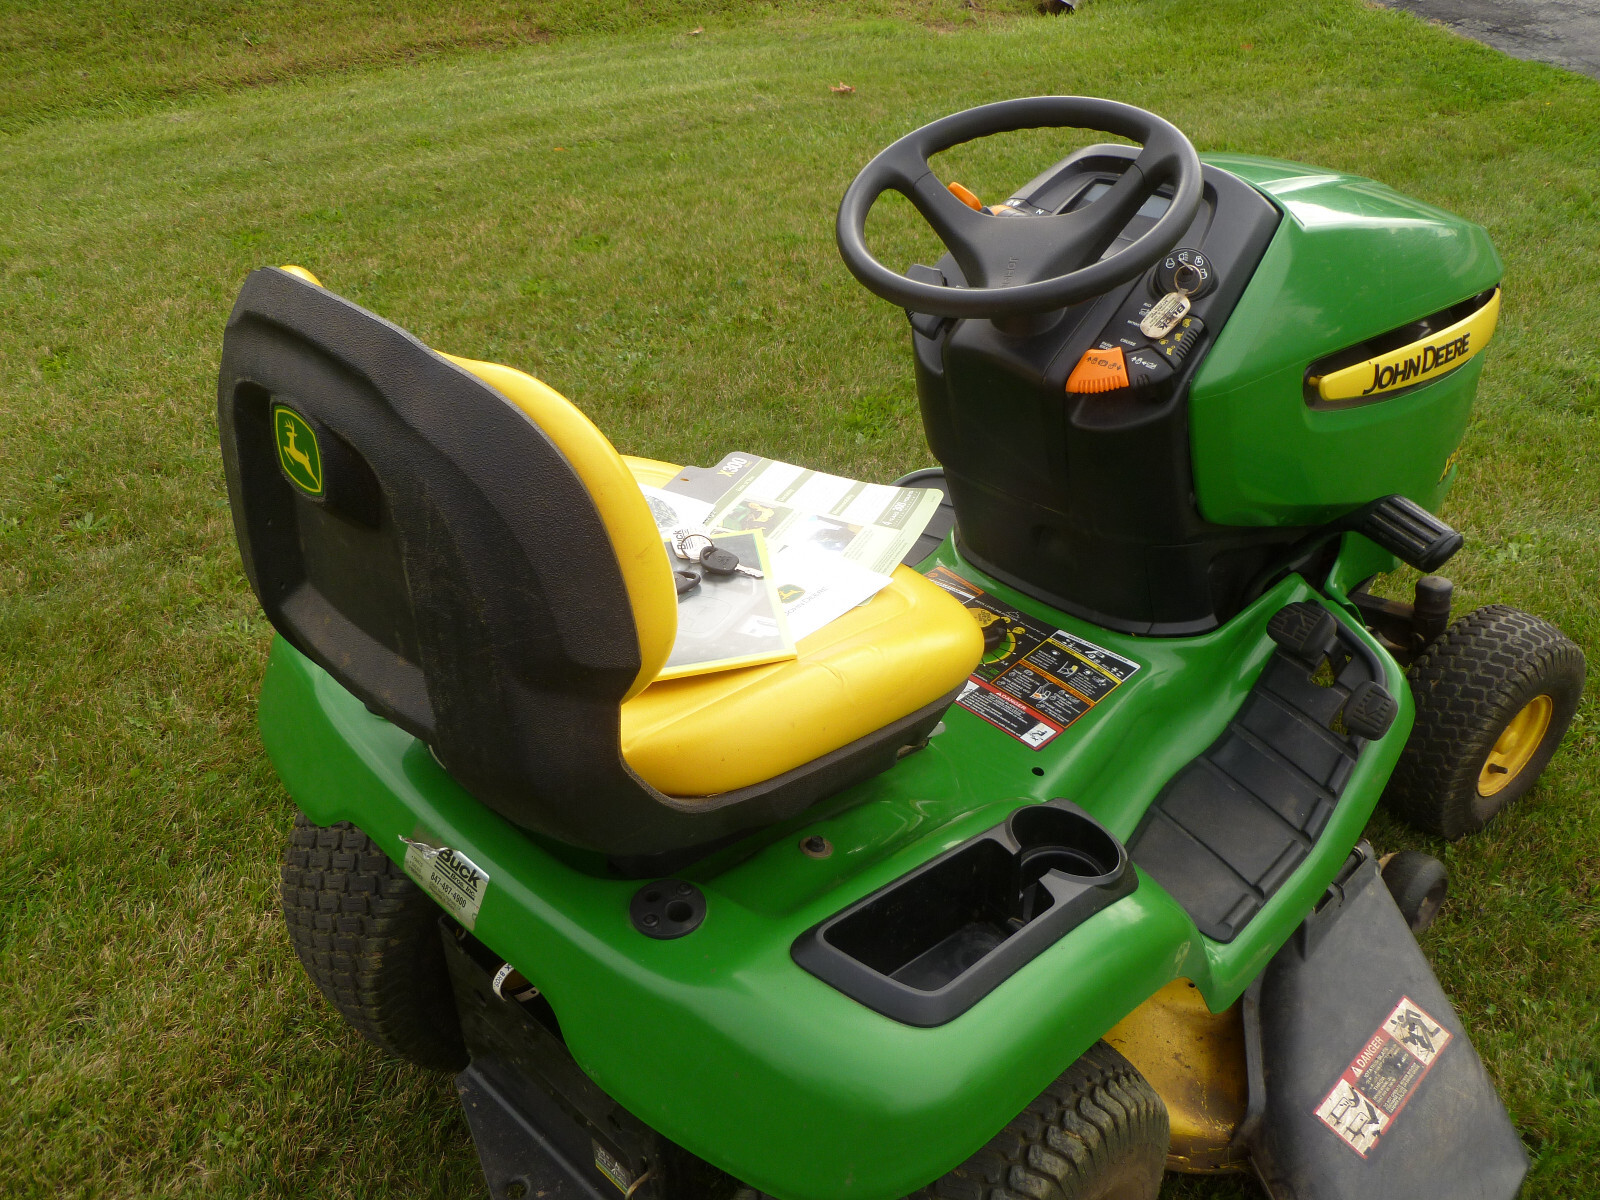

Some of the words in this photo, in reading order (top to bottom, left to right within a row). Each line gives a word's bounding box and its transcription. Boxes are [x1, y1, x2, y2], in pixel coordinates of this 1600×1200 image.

[1362, 355, 1421, 395] JOHN
[1421, 332, 1471, 374] DEERE
[717, 457, 748, 477] X300
[1000, 695, 1027, 711] DANGER
[1358, 1035, 1384, 1068] DANGER
